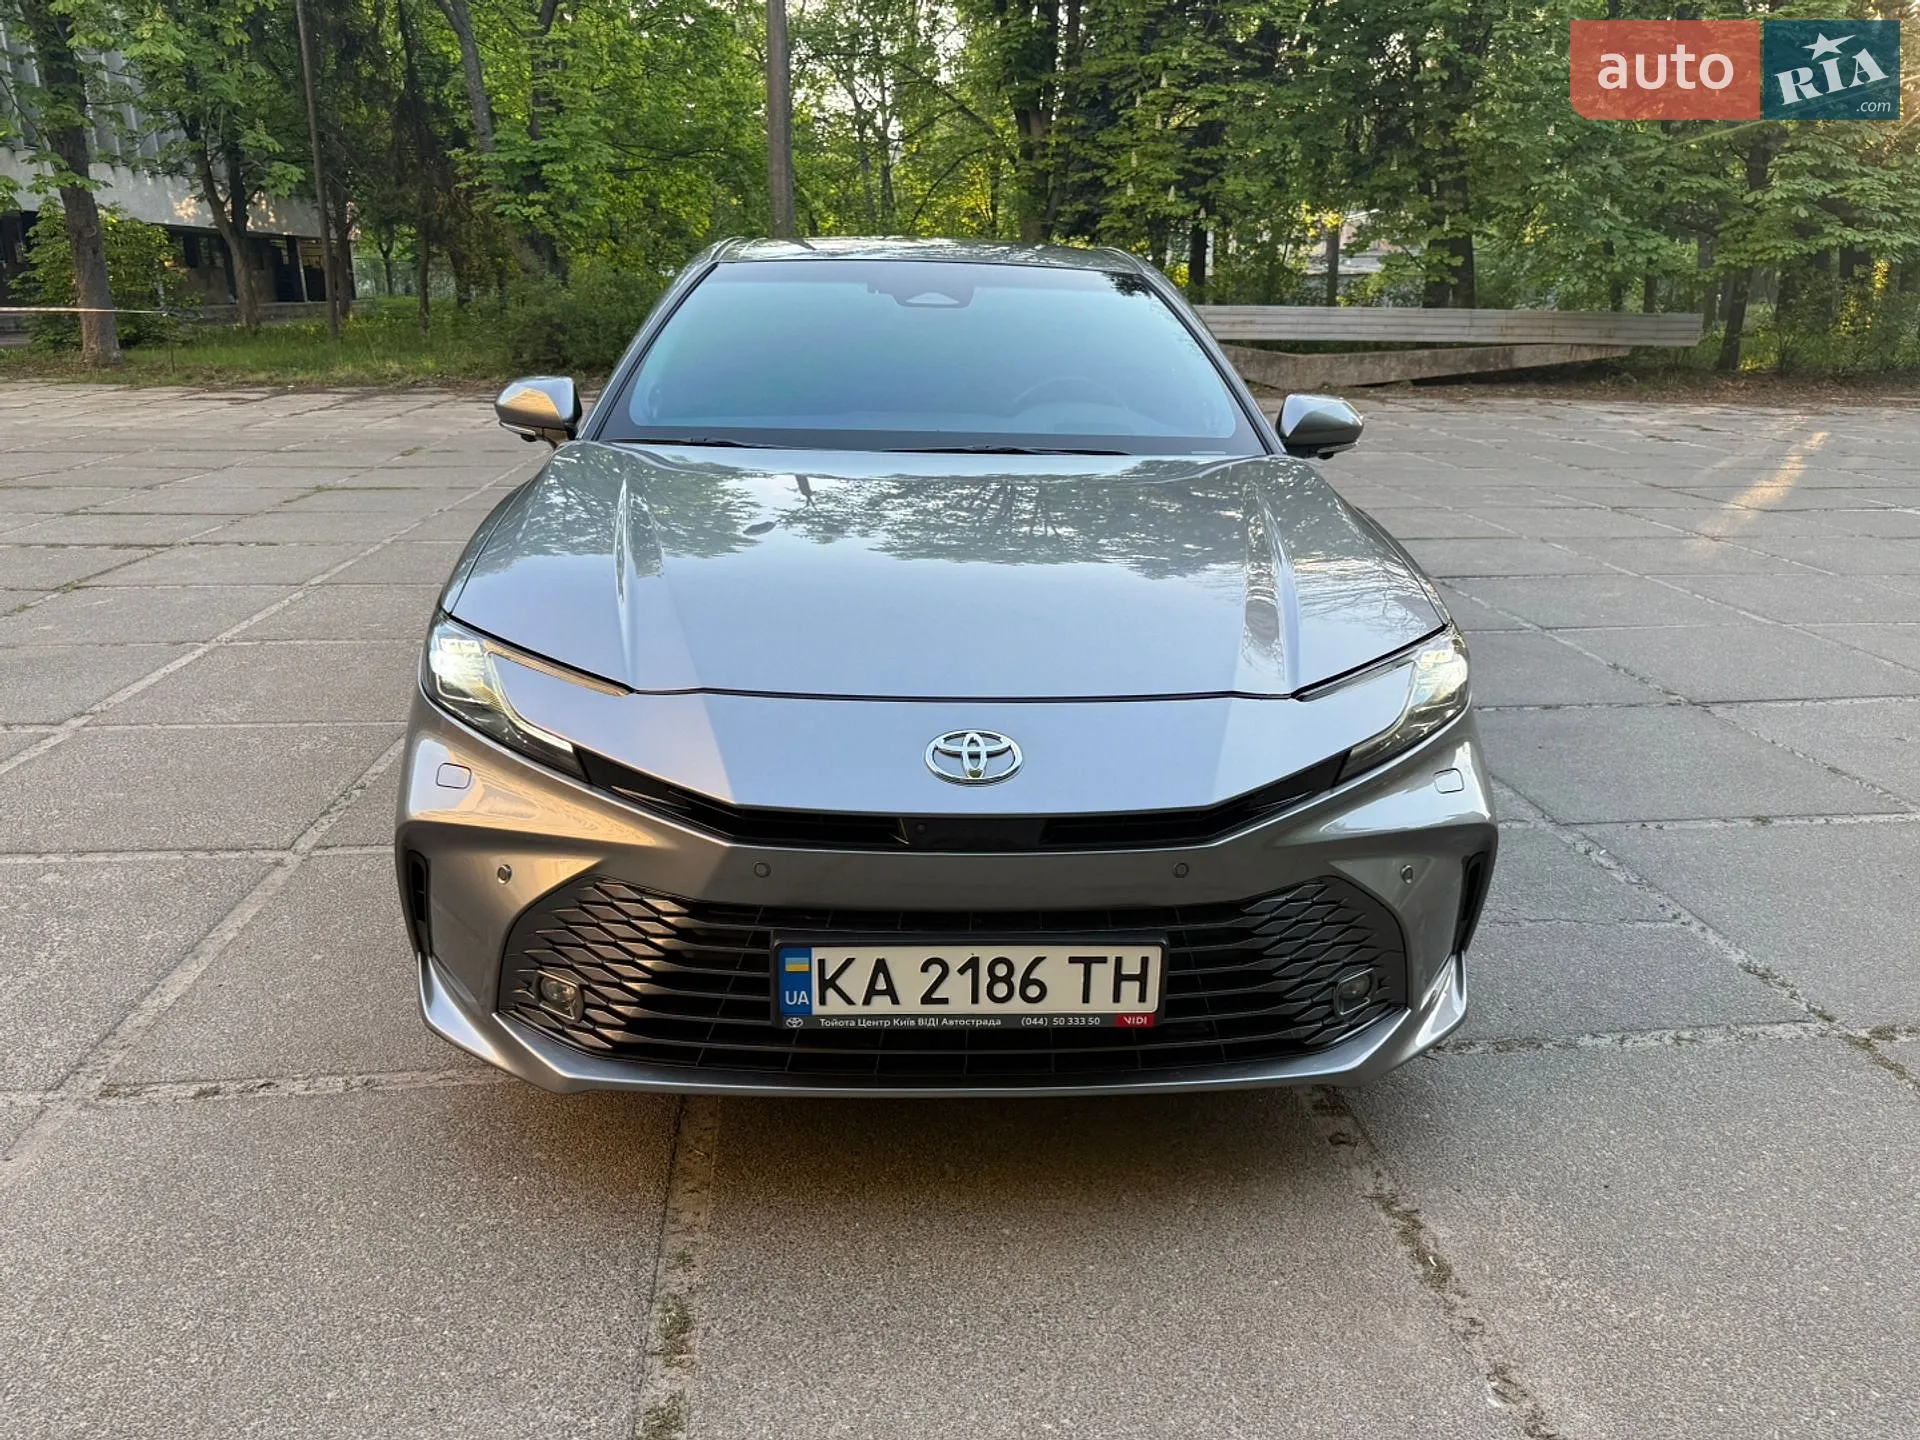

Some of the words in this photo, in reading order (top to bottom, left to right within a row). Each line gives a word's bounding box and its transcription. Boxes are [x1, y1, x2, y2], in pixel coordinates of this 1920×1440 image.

[816, 957, 901, 1007] KA
[919, 955, 1048, 1006] 2186
[1067, 955, 1150, 1004] TH
[785, 990, 810, 1006] UA
[820, 1018, 856, 1027] Тойота
[857, 1018, 891, 1028] Центр
[893, 1017, 916, 1027] Київ
[941, 1017, 1002, 1028] Автострада
[1021, 1017, 1048, 1027] (044)
[1052, 1017, 1065, 1026] 50
[1067, 1017, 1086, 1026] 333
[1088, 1017, 1101, 1026] 50
[1122, 1016, 1148, 1025] VIDI
